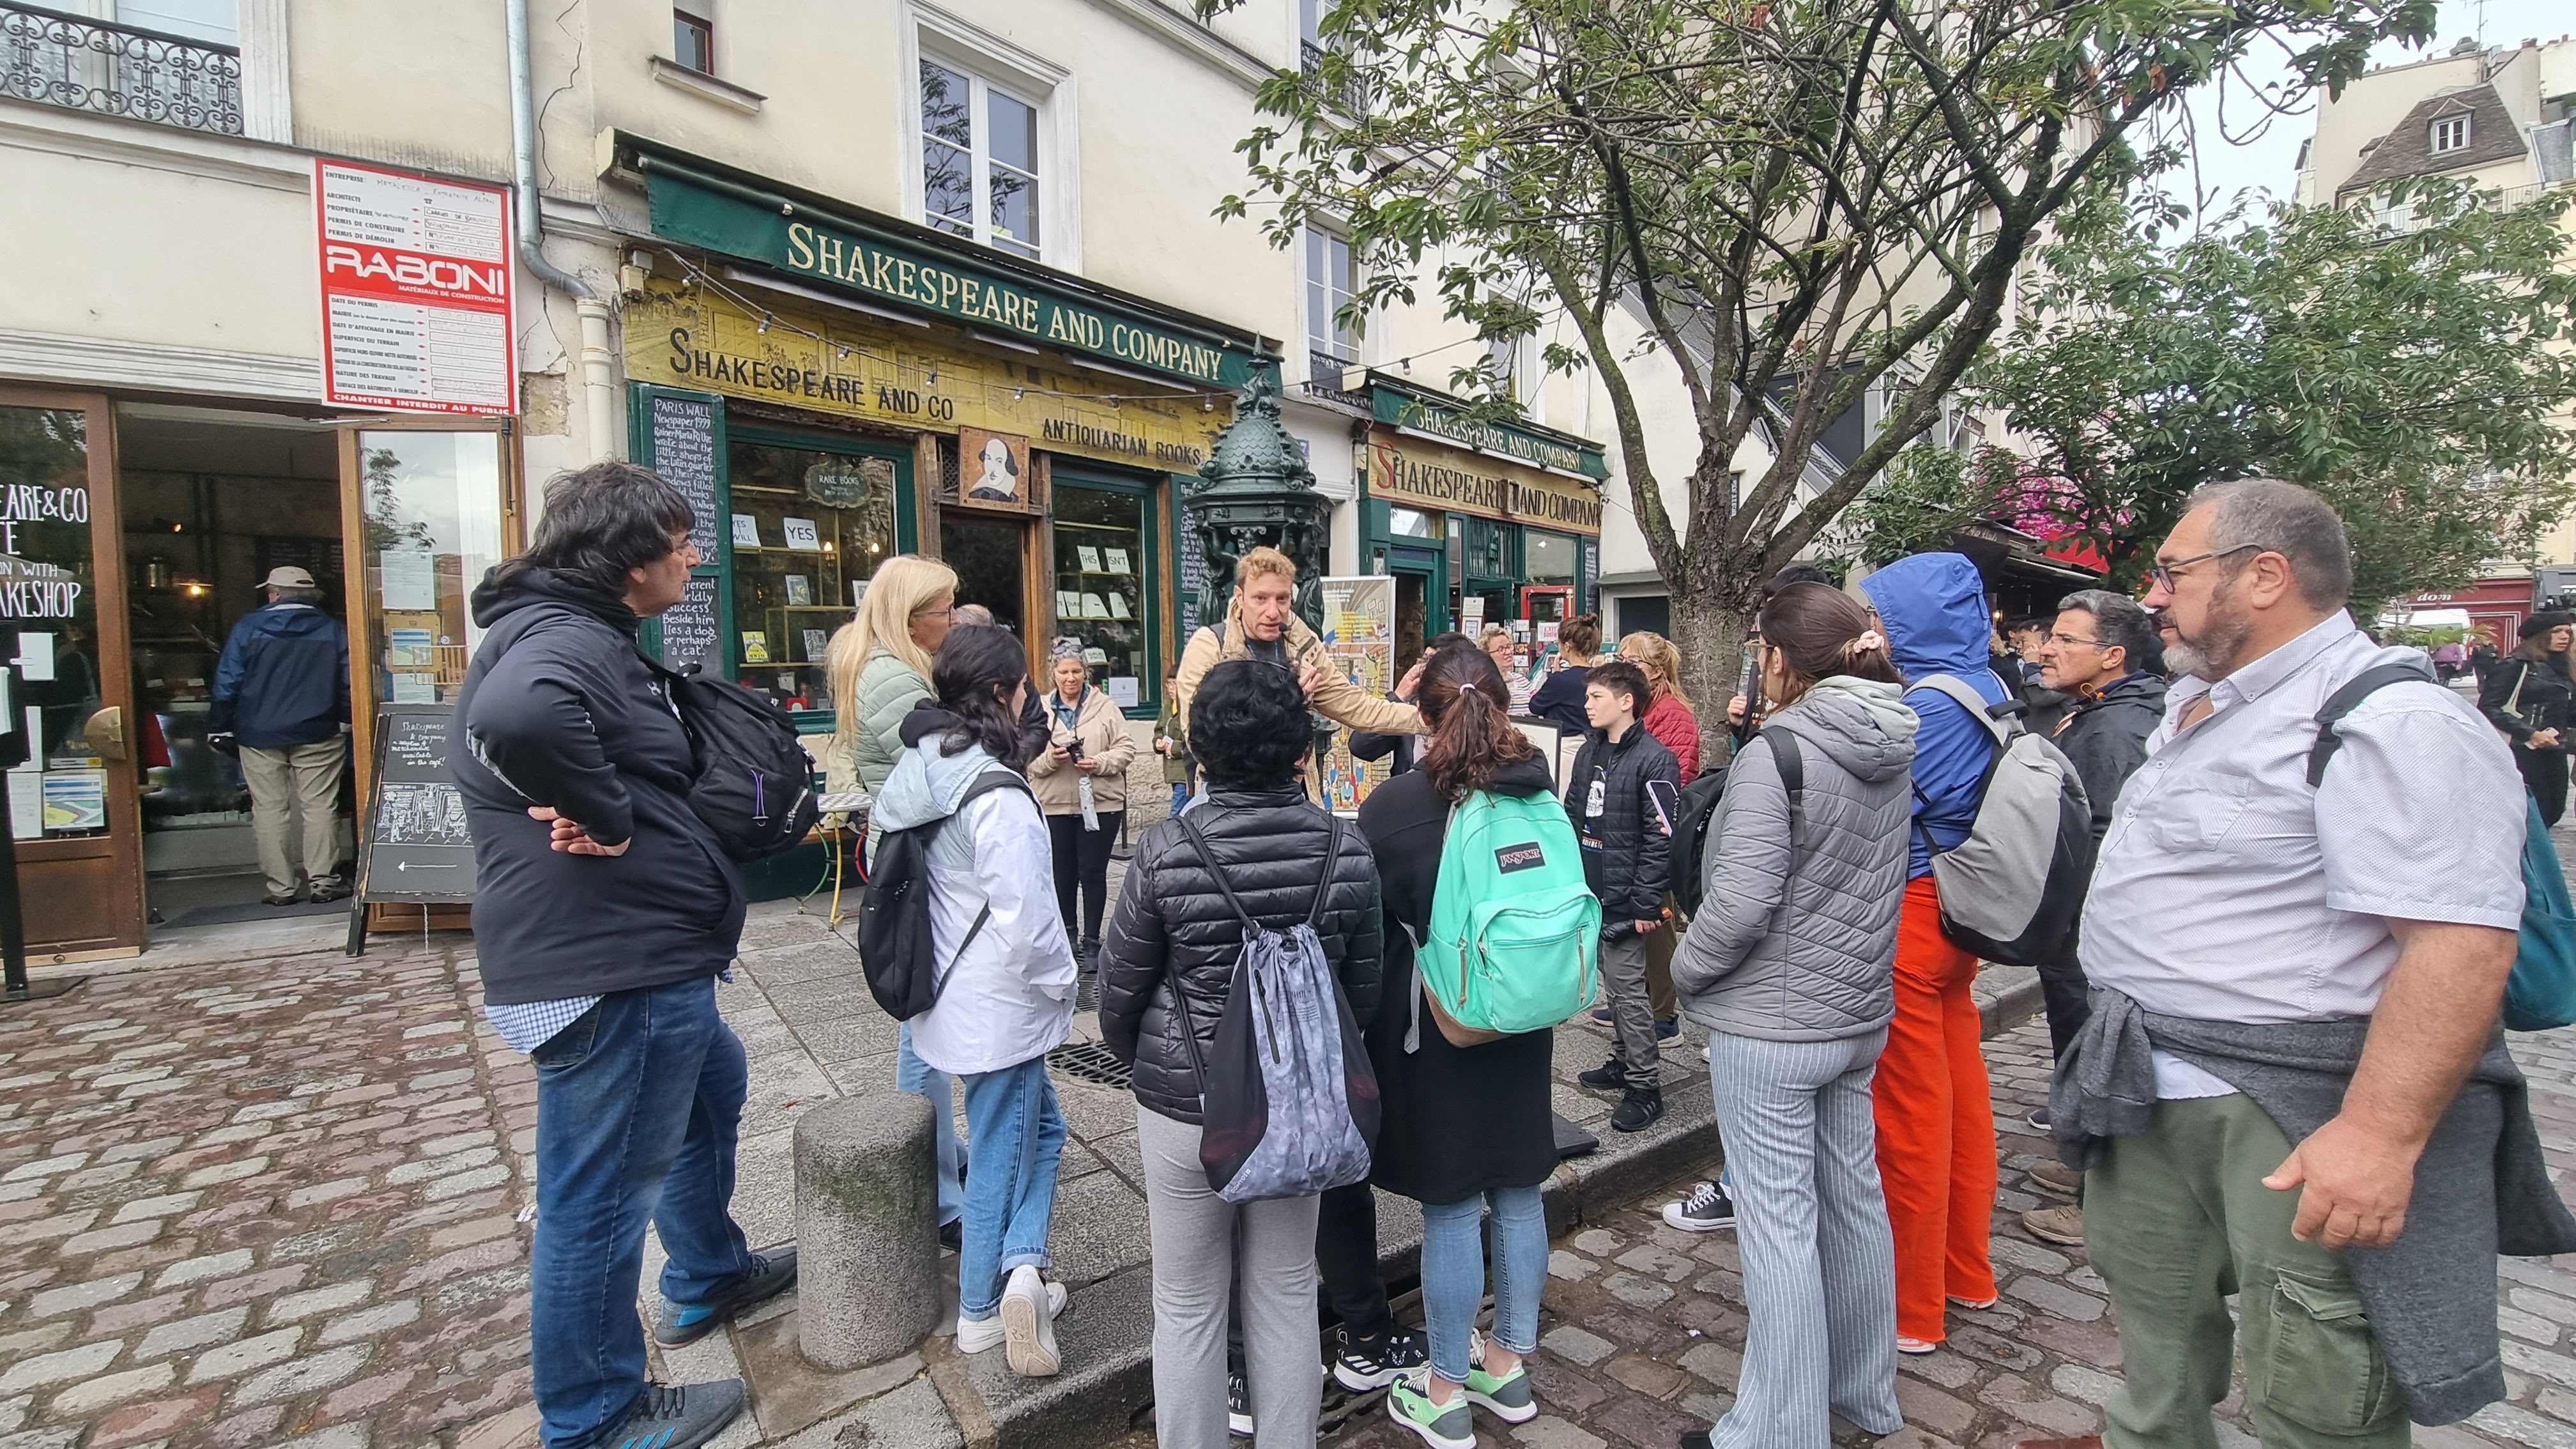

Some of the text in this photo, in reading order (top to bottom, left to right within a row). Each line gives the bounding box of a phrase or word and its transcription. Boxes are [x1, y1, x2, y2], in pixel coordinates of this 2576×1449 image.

[326, 171, 364, 183] ENTREPRISE
[326, 192, 361, 202] ARCHITECTE
[327, 204, 373, 217] PROPRIÉTAIRE
[328, 216, 352, 226] PERMIS
[365, 222, 405, 233] CONSTRUIRE
[328, 228, 353, 237] PERMIS
[365, 233, 395, 243] DÉMOLIR
[326, 245, 504, 296] RABONI
[398, 284, 438, 297] MATÉRIAUX
[450, 292, 505, 303] CONSTRUCTION
[788, 222, 1223, 381] SHAKESPEARE AND COMPANY
[333, 334, 364, 342] SUPERFICIE
[670, 326, 953, 421] SHAKESPEARE AND CO
[334, 394, 392, 405] CHANTIER
[396, 399, 448, 411] INTERDIT
[472, 406, 510, 415] PUBLIC
[655, 398, 711, 418] PARIS WALL
[654, 411, 710, 429] Newspaper 1999
[654, 438, 713, 454] wrote about the
[1043, 418, 1201, 466] ANTIQUARIAN BOOKS
[679, 450, 702, 463] shops
[1508, 434, 1531, 459] AND
[1533, 441, 1581, 471] COMPANY
[656, 456, 670, 466] the
[656, 466, 714, 484] with their shop
[818, 474, 860, 486] RARE BOOKS
[1376, 439, 1506, 510] SHAKESPEARE
[1520, 486, 1547, 515] AND
[693, 480, 714, 491] filled
[689, 488, 710, 499] books
[786, 526, 815, 541] YES
[1080, 554, 1126, 566] THIS ISN'T
[20, 562, 58, 578] WITH
[663, 613, 715, 625] Beside him
[664, 624, 717, 641] lies a dog
[677, 635, 711, 648] perhaps
[671, 645, 705, 656] a cat.
[401, 721, 445, 734] Shakespeare
[1499, 848, 1541, 868] JANSPORT
